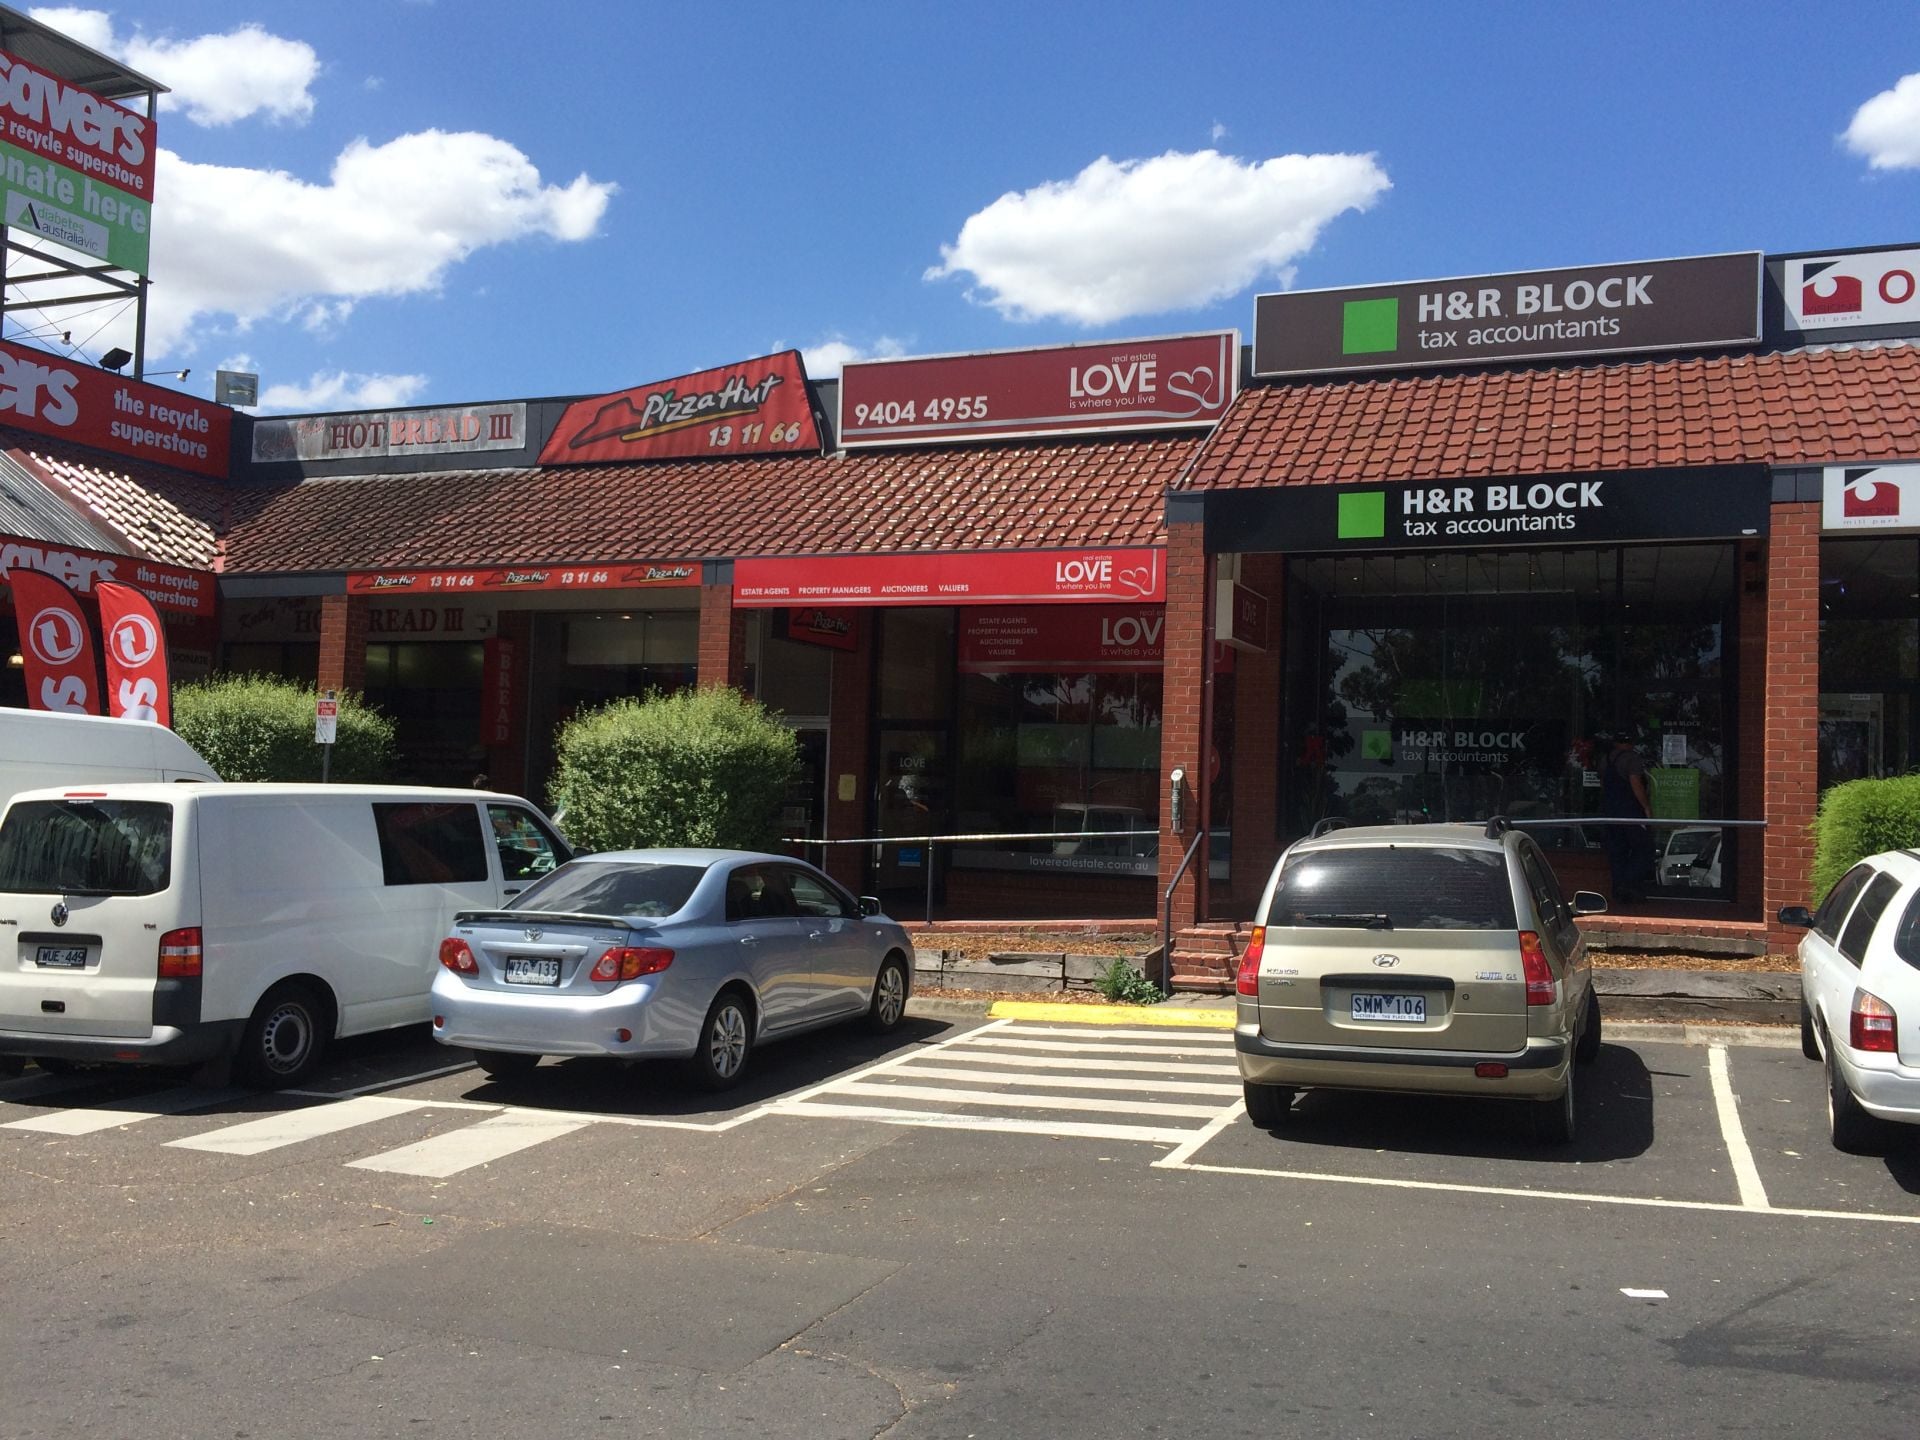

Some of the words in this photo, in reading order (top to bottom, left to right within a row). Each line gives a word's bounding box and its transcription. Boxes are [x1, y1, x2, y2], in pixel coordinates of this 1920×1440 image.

[10, 121, 62, 155] recycle
[67, 146, 144, 189] superstore
[0, 154, 75, 204] nate
[83, 178, 146, 233] here
[38, 205, 84, 233] diabetes
[1418, 288, 1502, 323] H&R
[1516, 275, 1654, 315] BLOCK
[1418, 328, 1458, 349] tax
[1467, 315, 1621, 346] accountants
[1111, 354, 1128, 363] real
[1129, 352, 1157, 362] estate
[1069, 360, 1157, 398] LOVE
[114, 388, 144, 416] the
[150, 403, 209, 434] recycle
[640, 390, 716, 430] Pizza
[718, 375, 784, 410] Hut
[854, 399, 917, 426] 9404
[923, 395, 988, 420] 4955
[1069, 398, 1077, 409] is
[1079, 398, 1112, 408] where
[1114, 396, 1135, 408] you
[1137, 394, 1156, 405] live
[110, 420, 208, 460] superstore
[330, 421, 386, 450] HOT
[389, 415, 481, 447] BREAD
[709, 424, 733, 448] 13
[741, 423, 764, 445] 11
[769, 421, 801, 444] 66
[1403, 487, 1475, 515] H&R
[1487, 481, 1604, 512] BLOCK
[1403, 519, 1438, 536] tax
[1445, 512, 1576, 535] accountants
[137, 566, 157, 584] the
[159, 574, 200, 591] recycle
[374, 576, 398, 586] Pizza
[397, 575, 418, 585] Hut
[430, 576, 442, 587] 13
[445, 576, 456, 586] 11
[459, 575, 475, 586] 66
[505, 571, 531, 583] Pizza
[531, 571, 551, 582] Hut
[561, 573, 574, 584] 13
[577, 572, 590, 583] 11
[592, 572, 608, 583] 66
[646, 567, 672, 580] Pizza
[672, 567, 695, 578] Hut
[1055, 560, 1113, 583] LOVE
[142, 587, 199, 608] uperstore
[741, 587, 763, 596] ESTATE
[764, 587, 790, 596] AGENTS
[798, 586, 831, 595] PROPERTY
[832, 586, 872, 594] MANAGERS
[881, 584, 929, 593] AUCTIONEERS
[938, 584, 970, 592] VALUERS
[1085, 583, 1098, 591] you
[368, 608, 437, 633] READ
[1102, 616, 1164, 646] LOV
[1401, 730, 1447, 747] H&R
[1454, 730, 1526, 749] BLOCK
[1401, 749, 1423, 761] tax
[1427, 750, 1509, 763] accountants
[1028, 855, 1149, 871] loverealestate.com.au
[1354, 997, 1383, 1014] SMM
[1396, 999, 1423, 1016] 106
